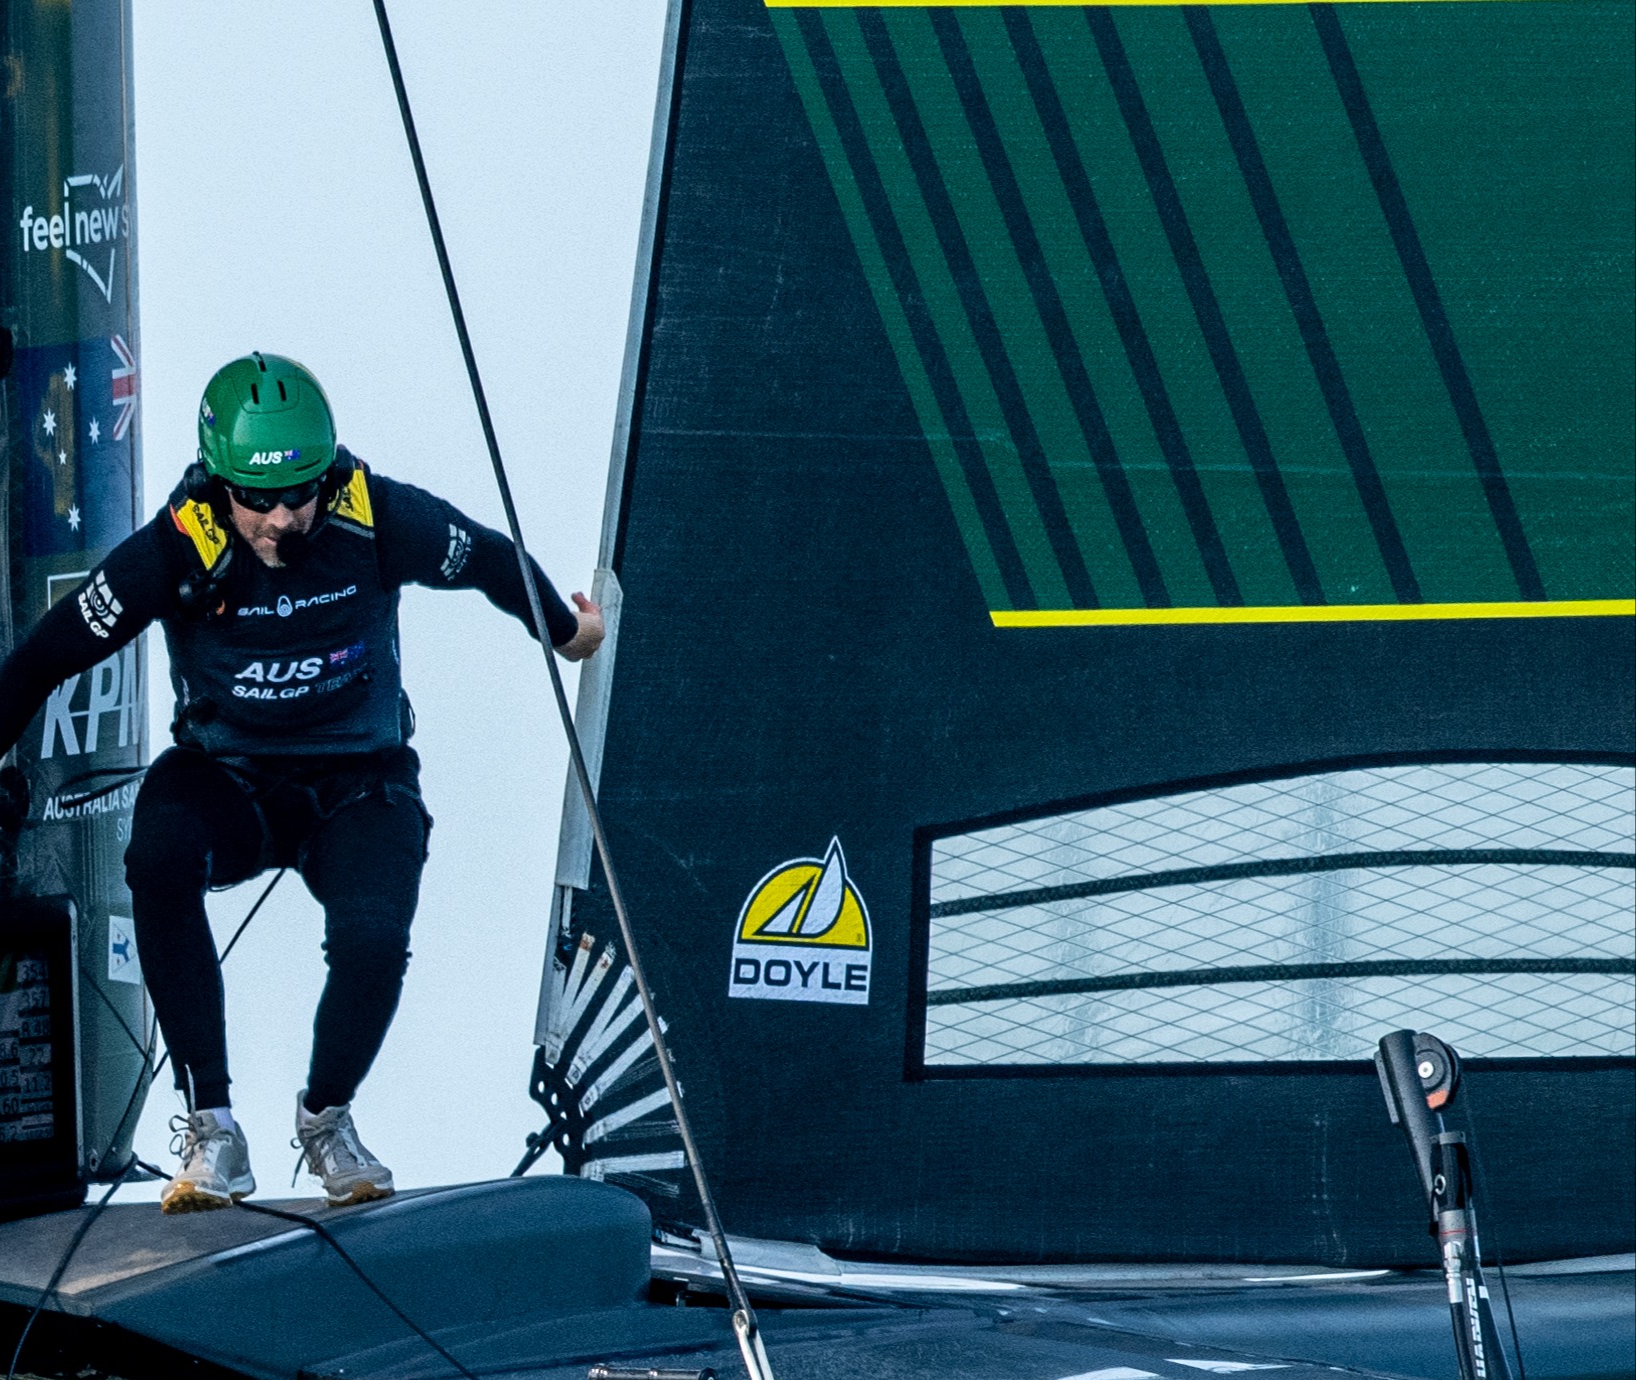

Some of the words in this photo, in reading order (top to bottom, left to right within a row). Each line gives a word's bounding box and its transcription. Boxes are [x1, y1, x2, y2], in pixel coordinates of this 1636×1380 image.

[20, 201, 70, 252] feel
[248, 451, 283, 465] AUS
[295, 584, 357, 610] RACING
[234, 657, 324, 683] AUS
[732, 957, 869, 992] DOYLE
